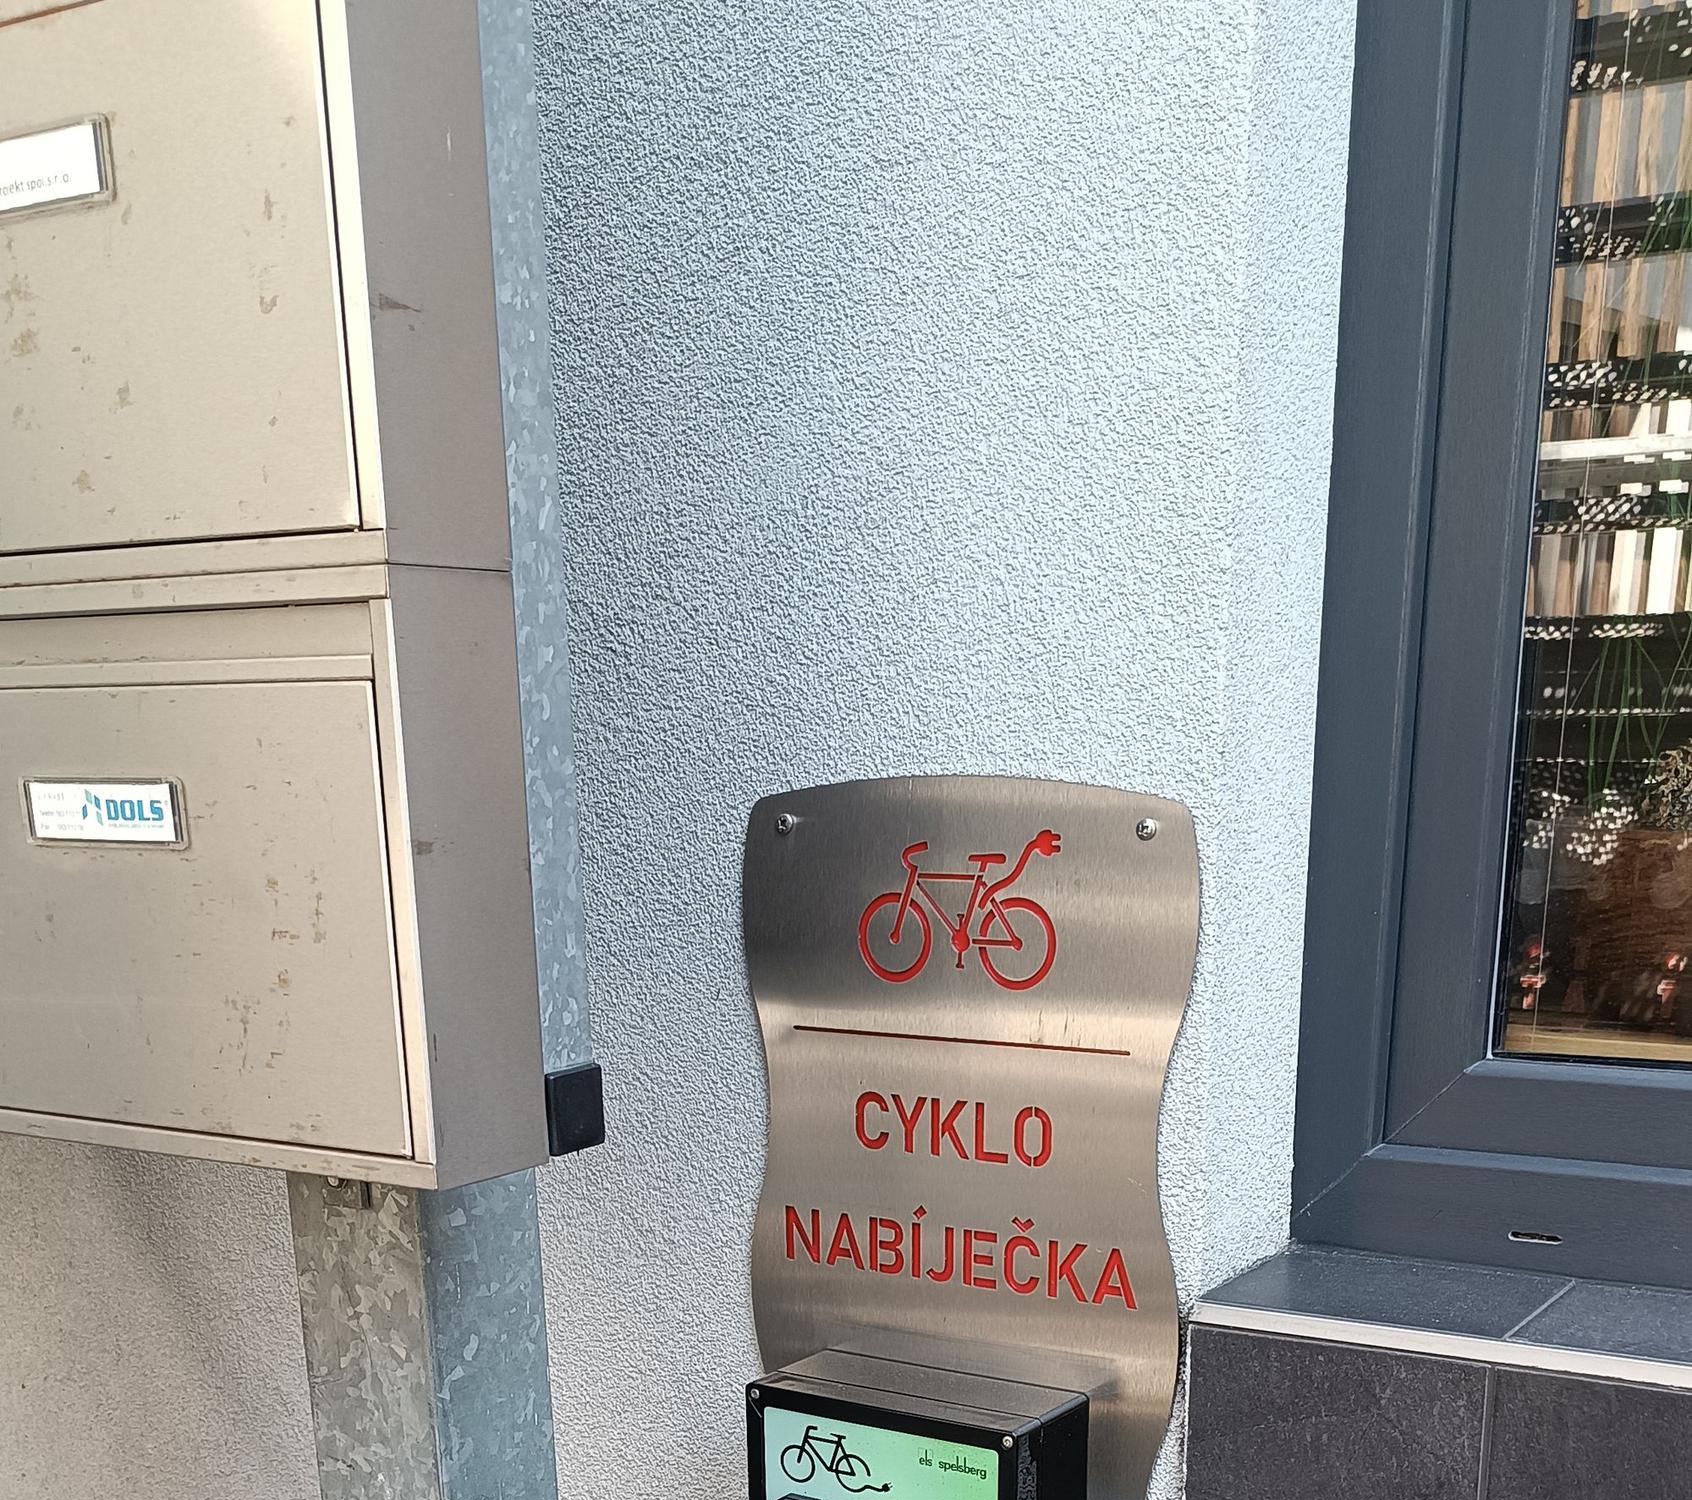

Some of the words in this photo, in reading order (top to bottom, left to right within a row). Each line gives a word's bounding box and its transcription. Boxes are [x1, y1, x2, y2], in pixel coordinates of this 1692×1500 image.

[105, 799, 164, 822] DOLS
[855, 1091, 1053, 1168] CYKLO
[784, 1204, 1137, 1310] NABÍJEČKA
[919, 1449, 932, 1467] els
[938, 1456, 987, 1480] spelsberg
